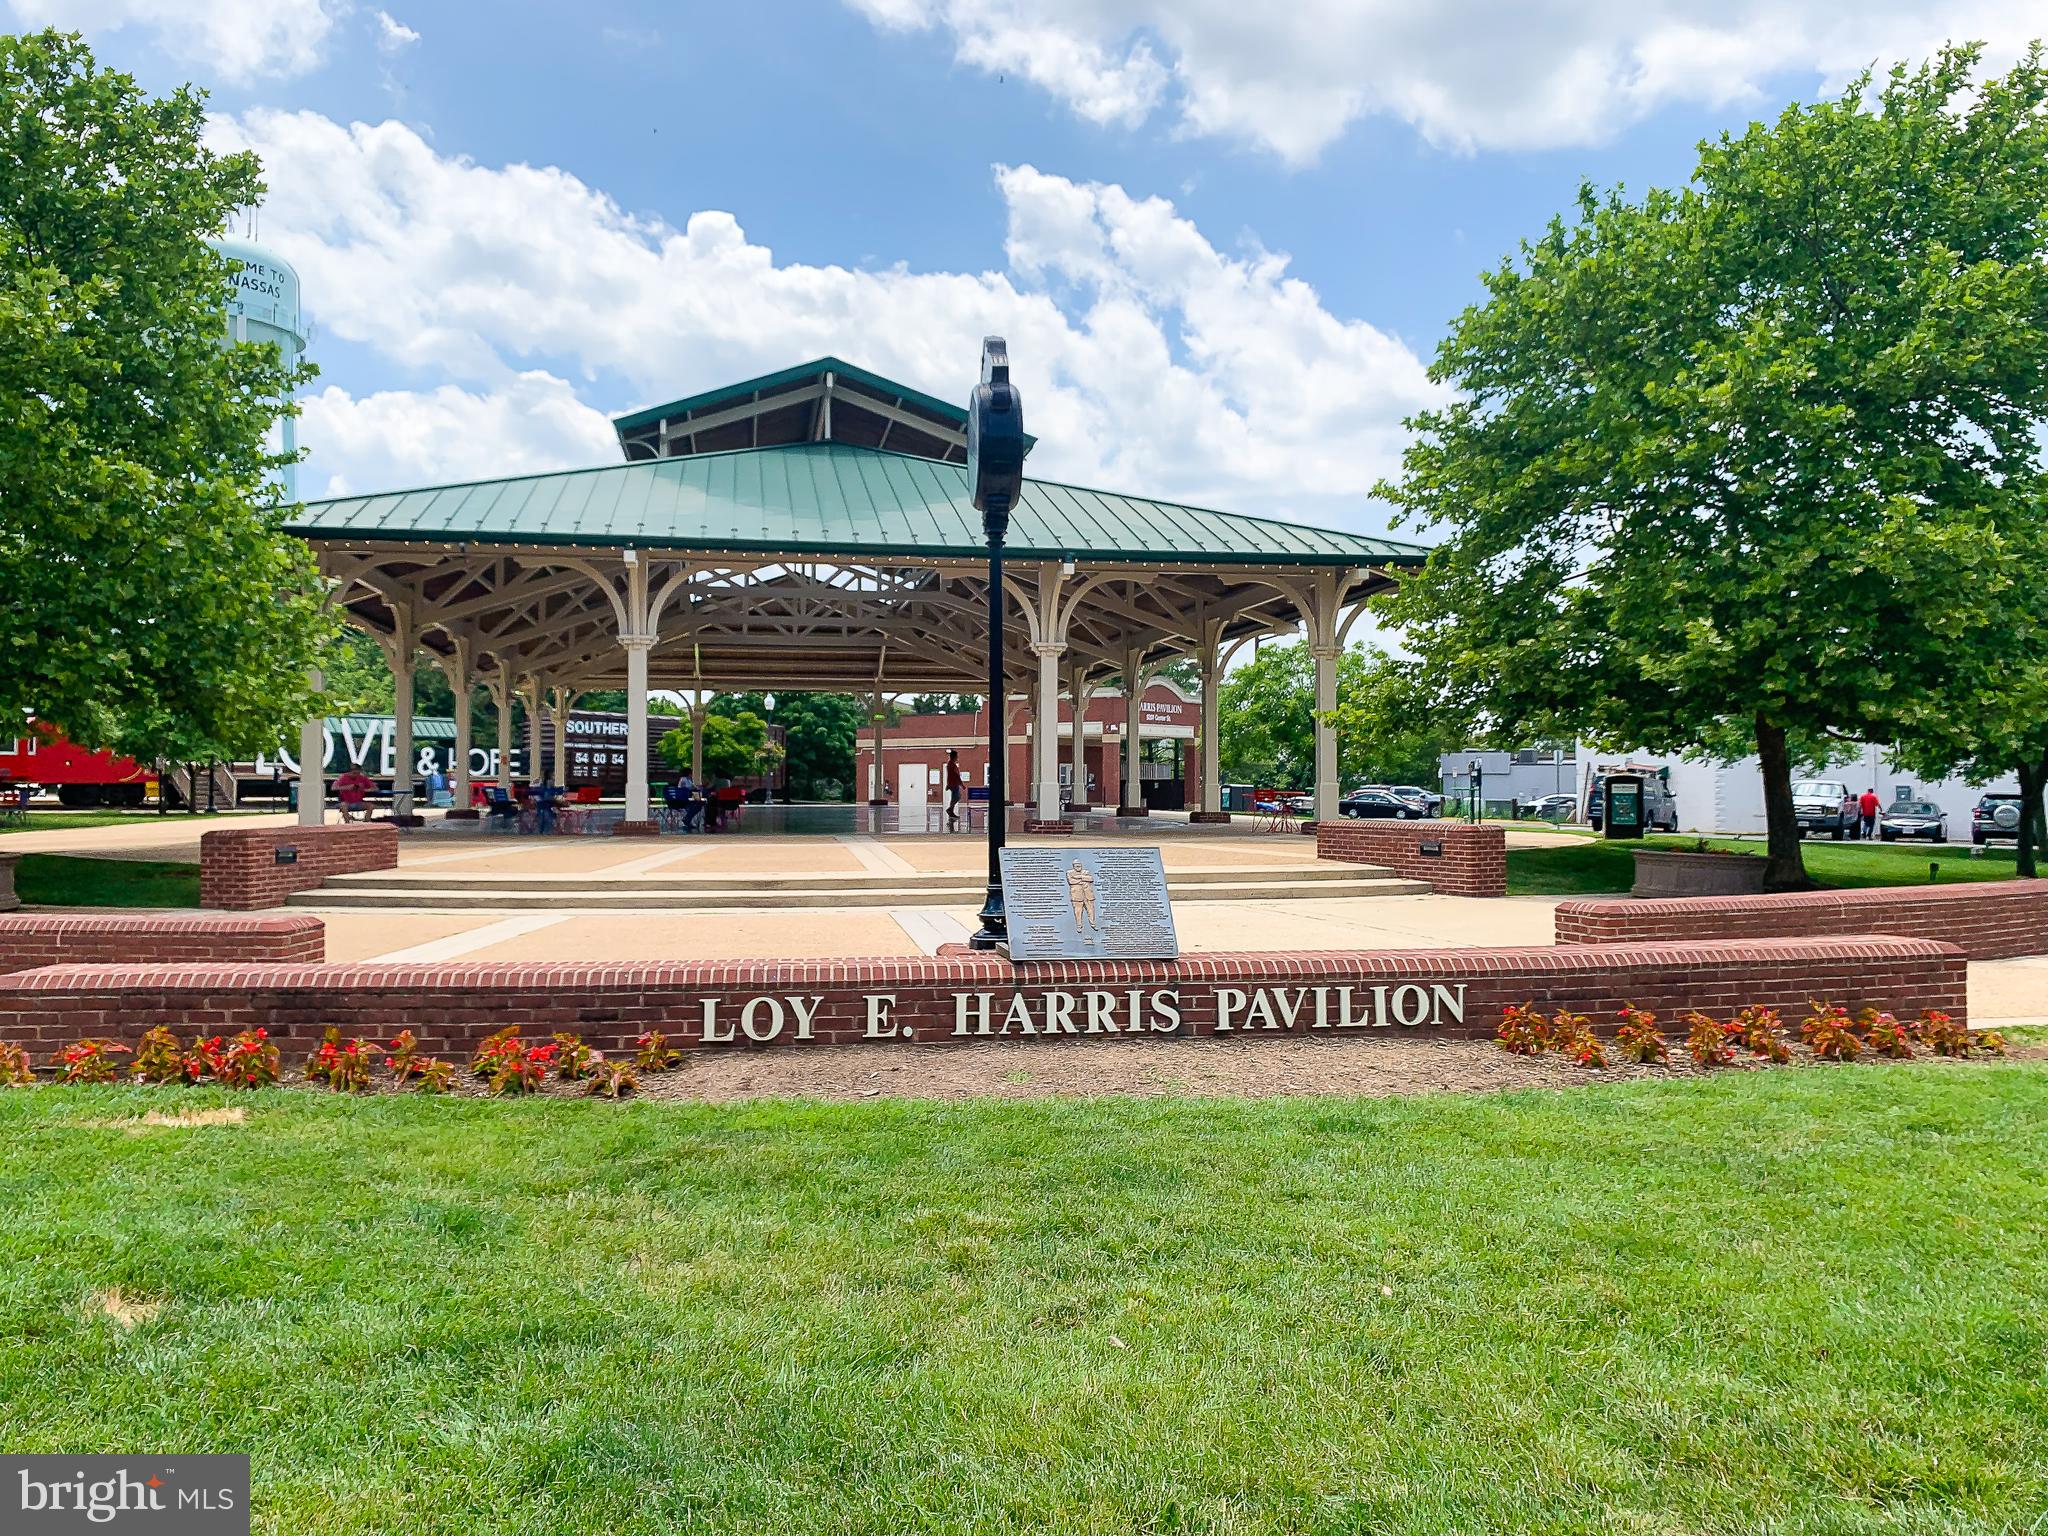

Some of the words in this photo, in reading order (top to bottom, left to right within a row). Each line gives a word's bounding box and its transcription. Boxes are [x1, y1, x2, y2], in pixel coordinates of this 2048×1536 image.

[270, 269, 285, 283] TO
[229, 273, 281, 299] NASSAS
[1140, 702, 1156, 712] ARRIS
[1156, 703, 1182, 714] PAVILION
[566, 720, 629, 736] SOUTHER
[417, 747, 440, 777] &
[611, 753, 625, 765] 54
[699, 996, 825, 1042] LOY
[862, 994, 914, 1038] E.
[950, 990, 1181, 1036] HARRIS
[1213, 983, 1468, 1030] PAVILION
